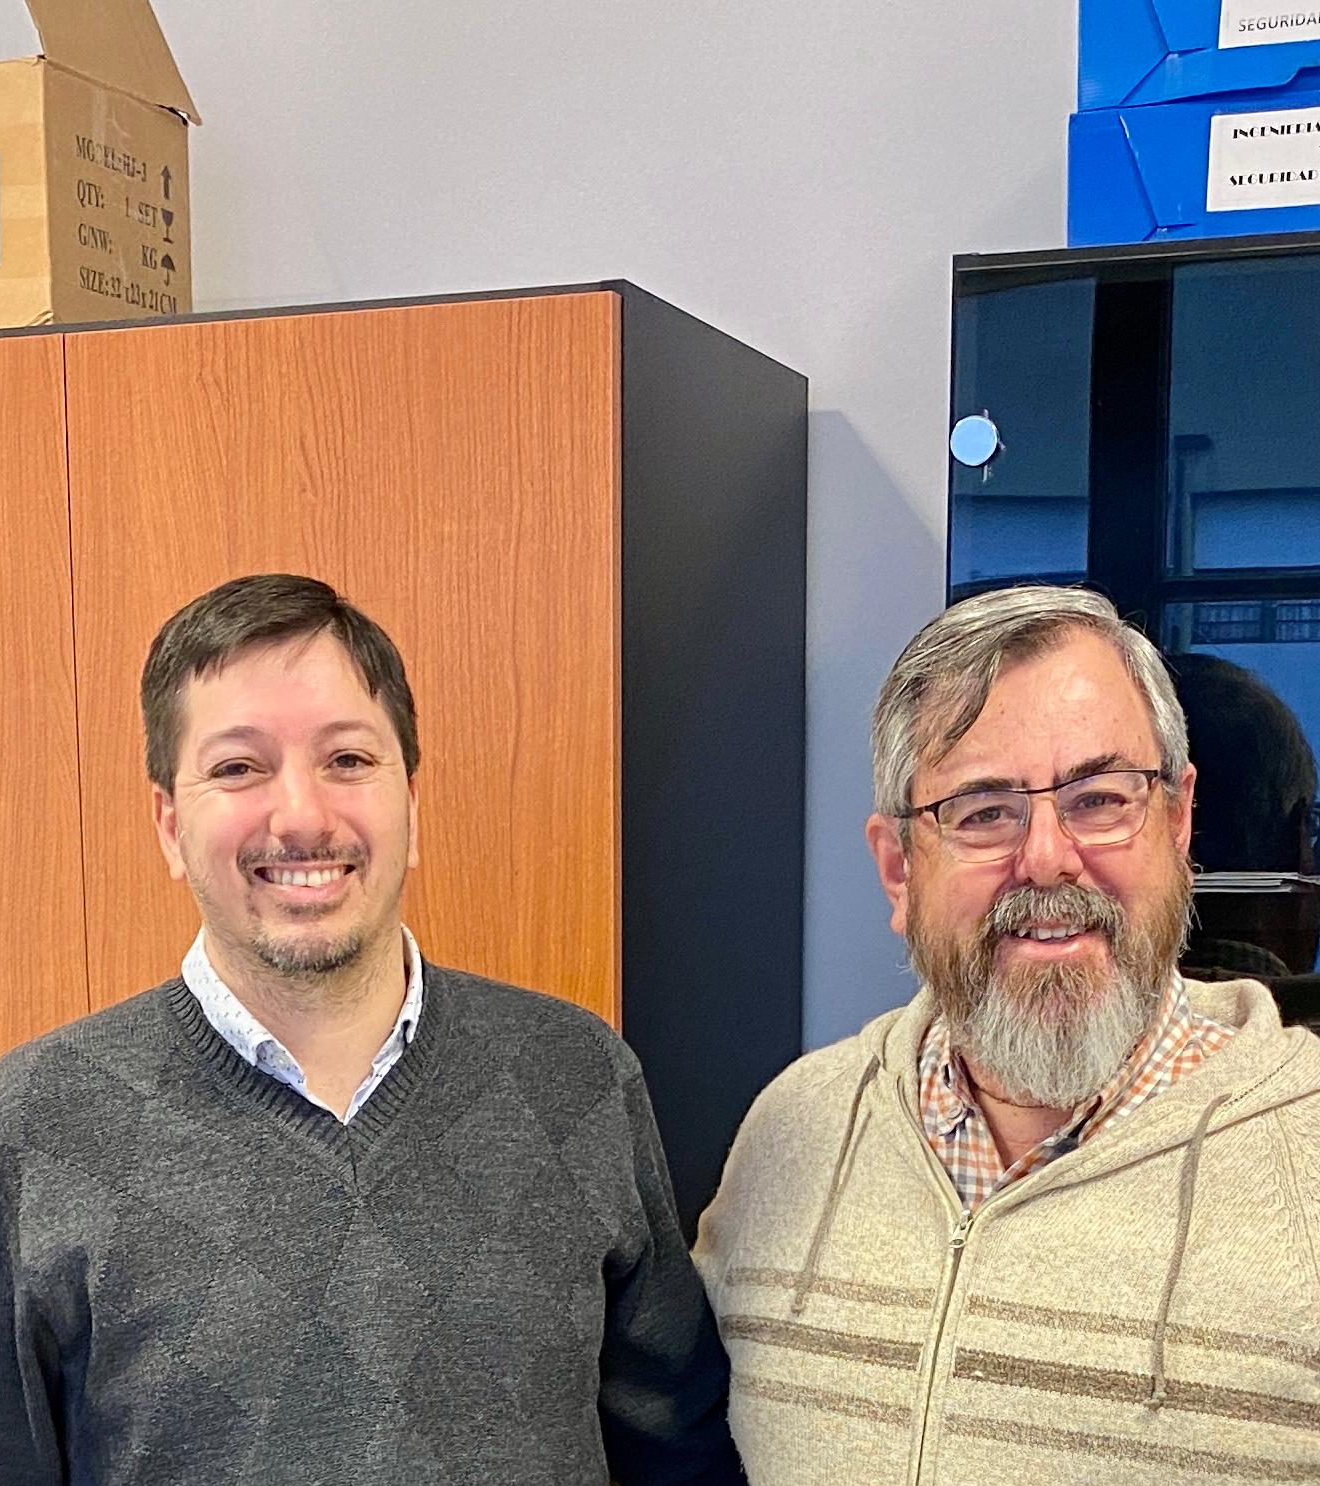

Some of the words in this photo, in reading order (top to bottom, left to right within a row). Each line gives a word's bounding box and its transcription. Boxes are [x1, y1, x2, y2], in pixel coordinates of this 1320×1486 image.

[1229, 168, 1319, 187] SEGURIDAD
[77, 179, 104, 209] QTY:
[138, 201, 158, 228] SET
[142, 244, 158, 270] KG
